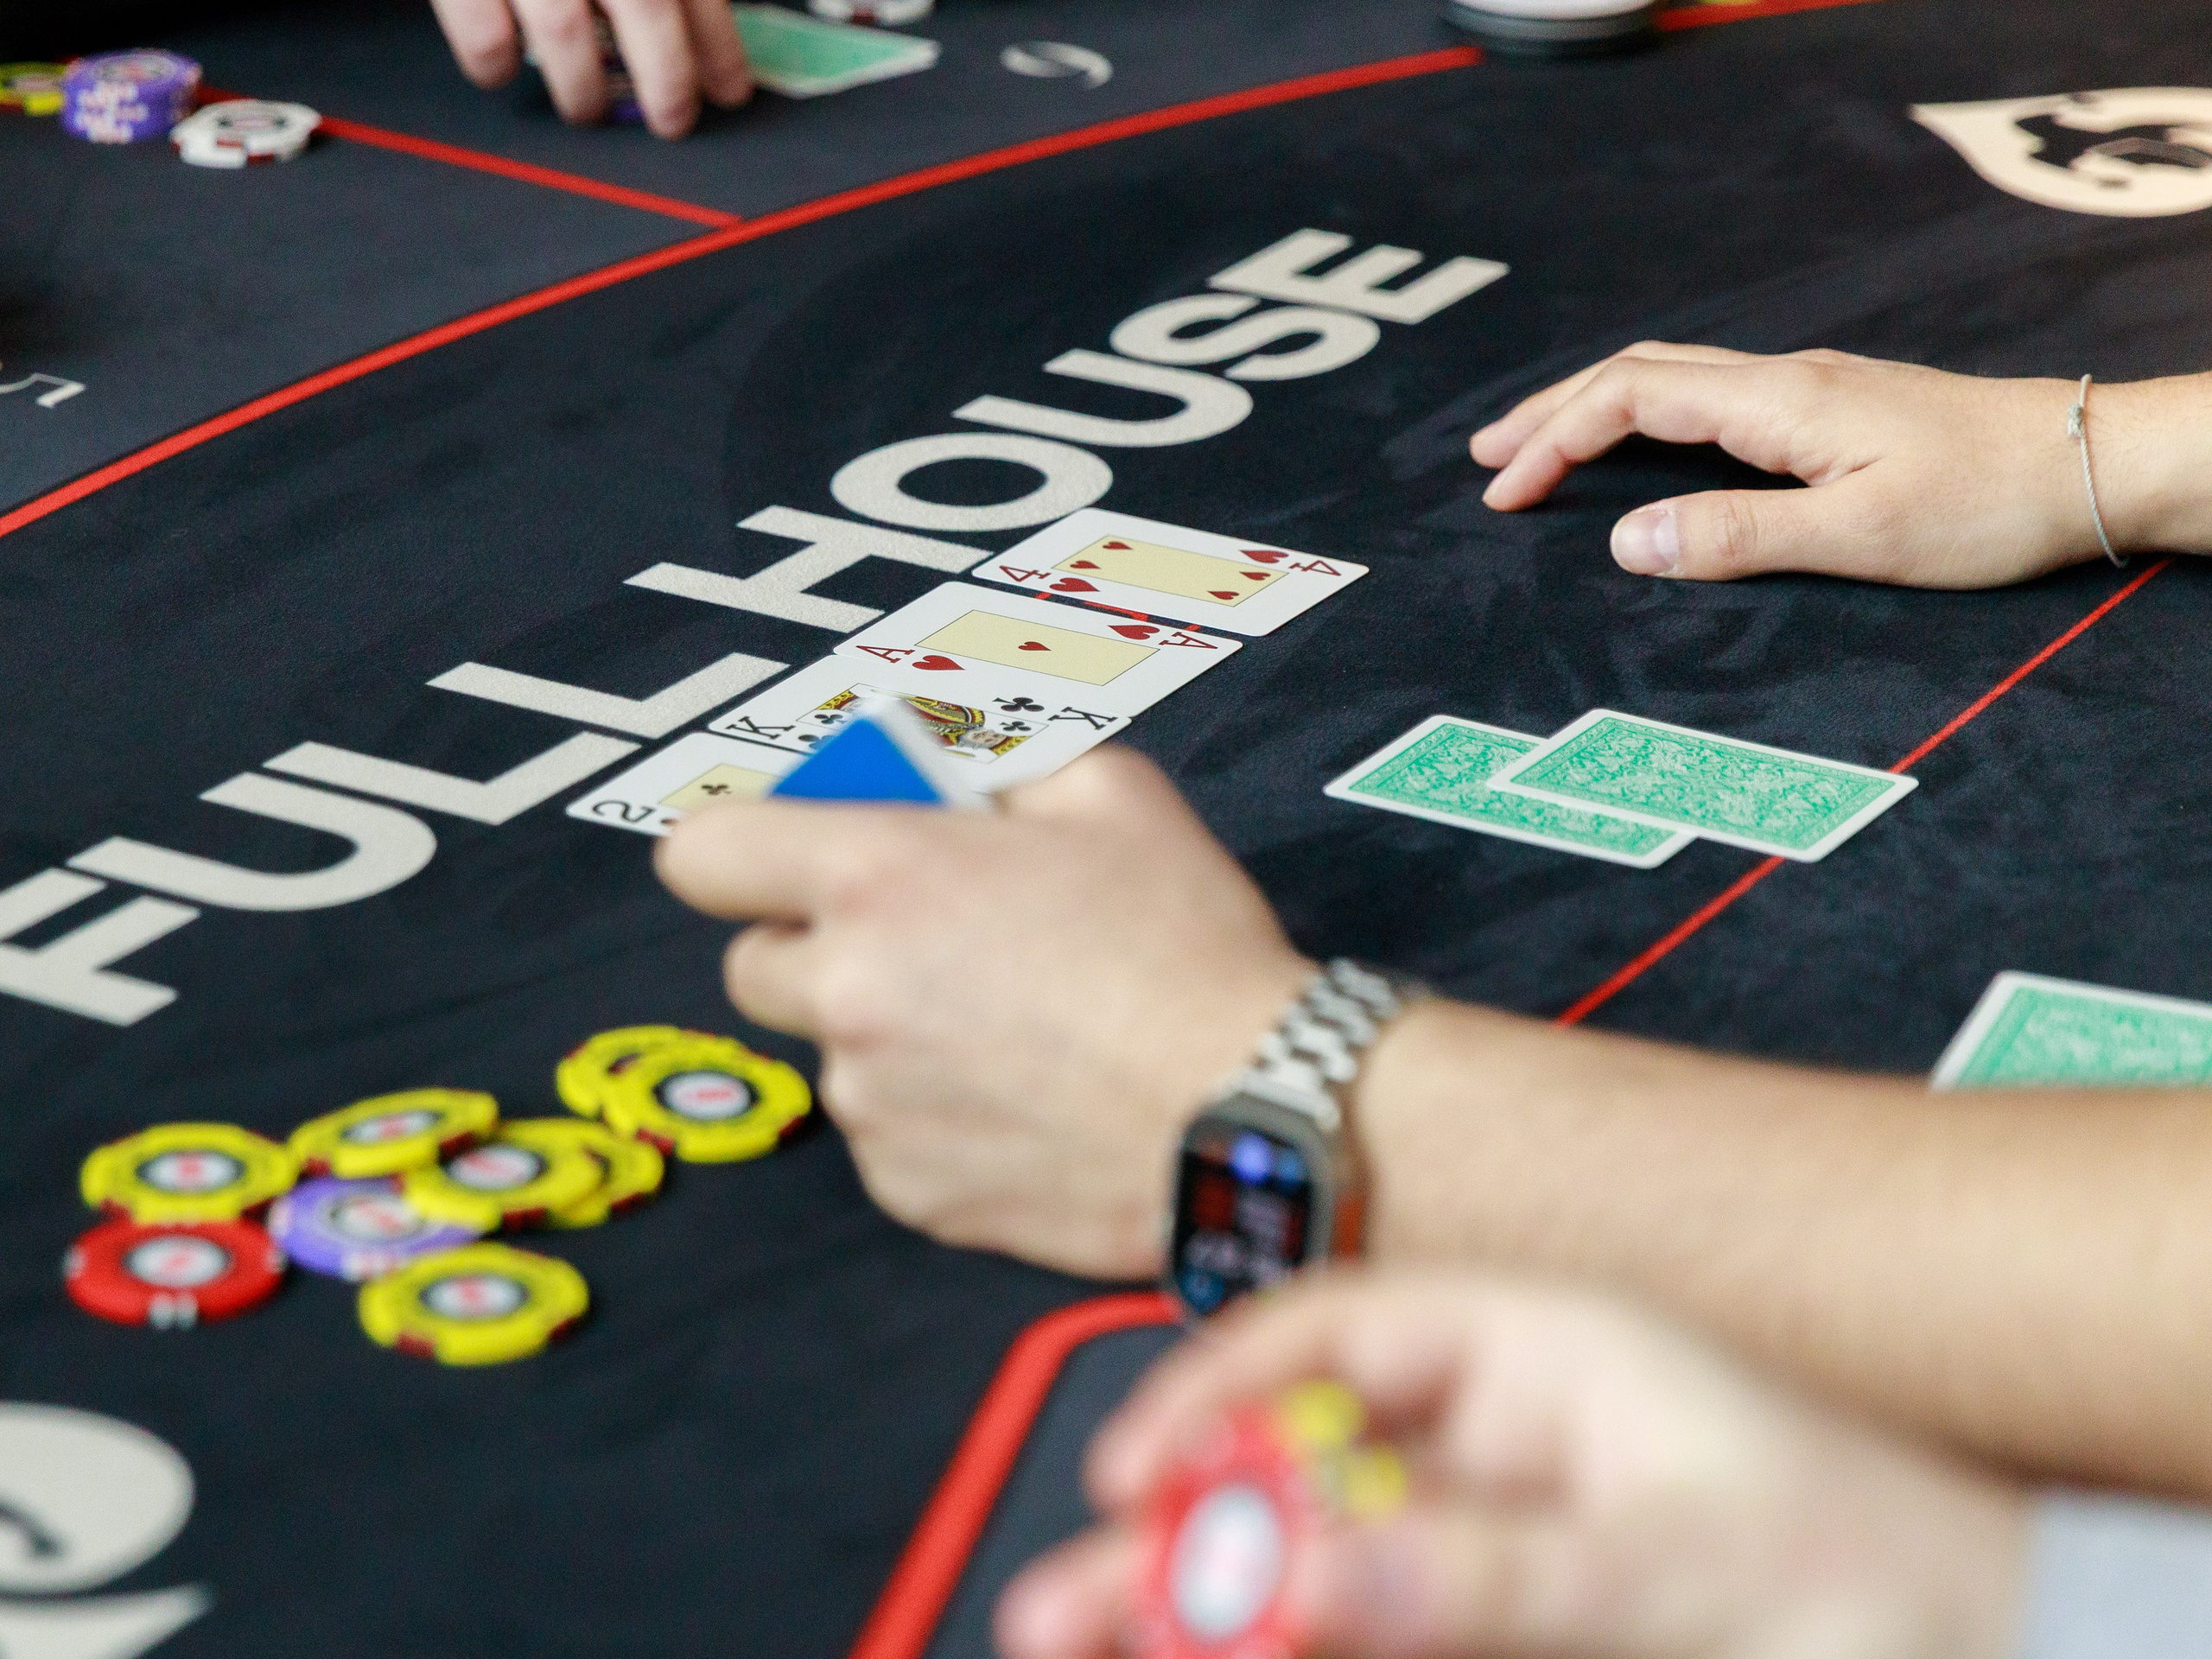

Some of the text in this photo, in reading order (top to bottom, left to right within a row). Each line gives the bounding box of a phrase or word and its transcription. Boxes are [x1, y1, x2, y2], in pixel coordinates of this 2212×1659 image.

[999, 564, 1052, 582] 4
[1289, 560, 1342, 576] 4
[0, 228, 1510, 1026] FULL HOUSE
[1158, 632, 1219, 650] A
[855, 645, 915, 664] A
[725, 715, 797, 740] K
[1047, 707, 1119, 730] K
[592, 799, 656, 824] 2
